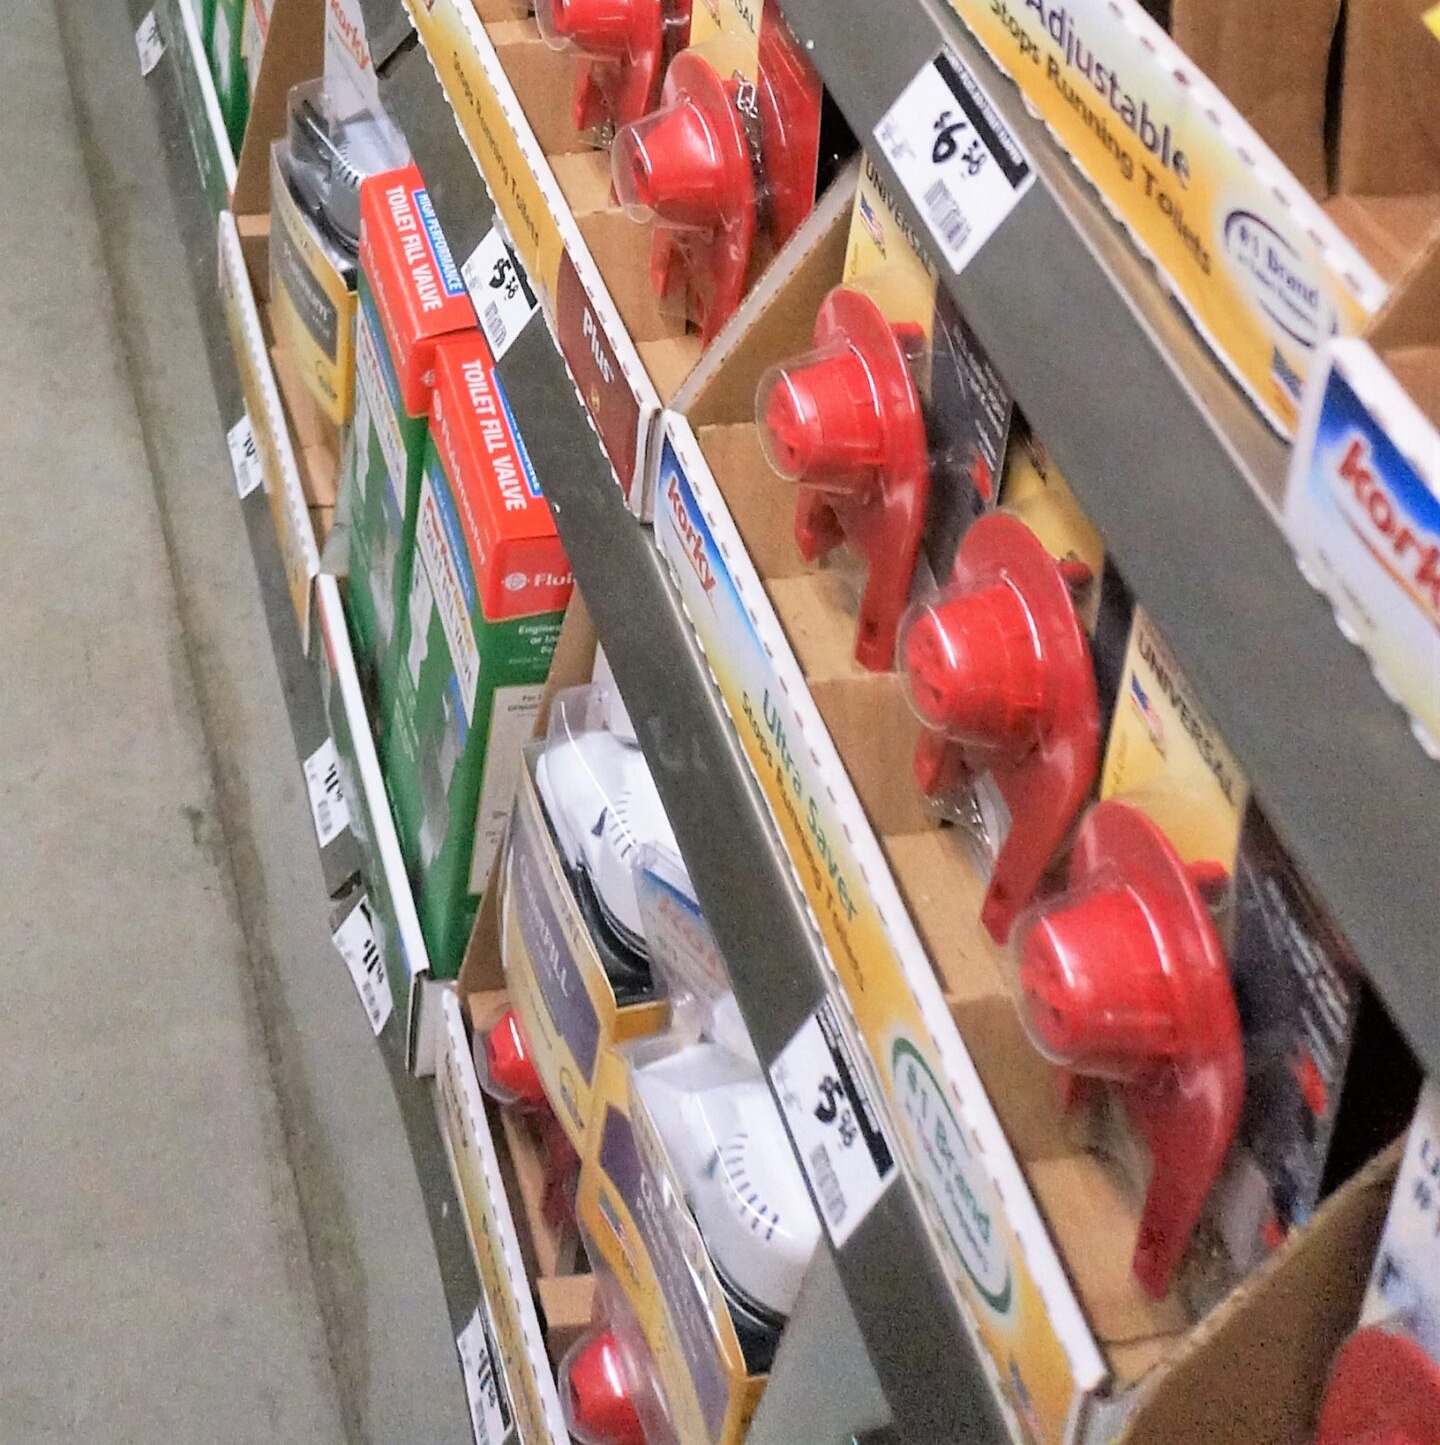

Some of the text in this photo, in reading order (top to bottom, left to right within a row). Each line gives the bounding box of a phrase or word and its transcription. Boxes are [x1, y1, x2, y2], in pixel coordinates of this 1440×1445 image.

[476, 97, 508, 187] Running
[511, 177, 539, 248] Toilets
[865, 161, 933, 278] UNIVERSAL
[1046, 57, 1134, 182] Running
[1144, 166, 1212, 277] Toilets
[385, 184, 443, 313] TOILET FILL VALVE
[417, 192, 463, 292] HIGH PERFORMANCE
[1267, 242, 1320, 308] Brand
[581, 307, 612, 384] Plus
[462, 360, 527, 512] TOILET FILL VALVE
[667, 478, 717, 592] korky
[1339, 439, 1440, 608] kork
[743, 689, 773, 768] Stops
[775, 766, 822, 891] Running
[763, 687, 858, 922] Ultra Saver
